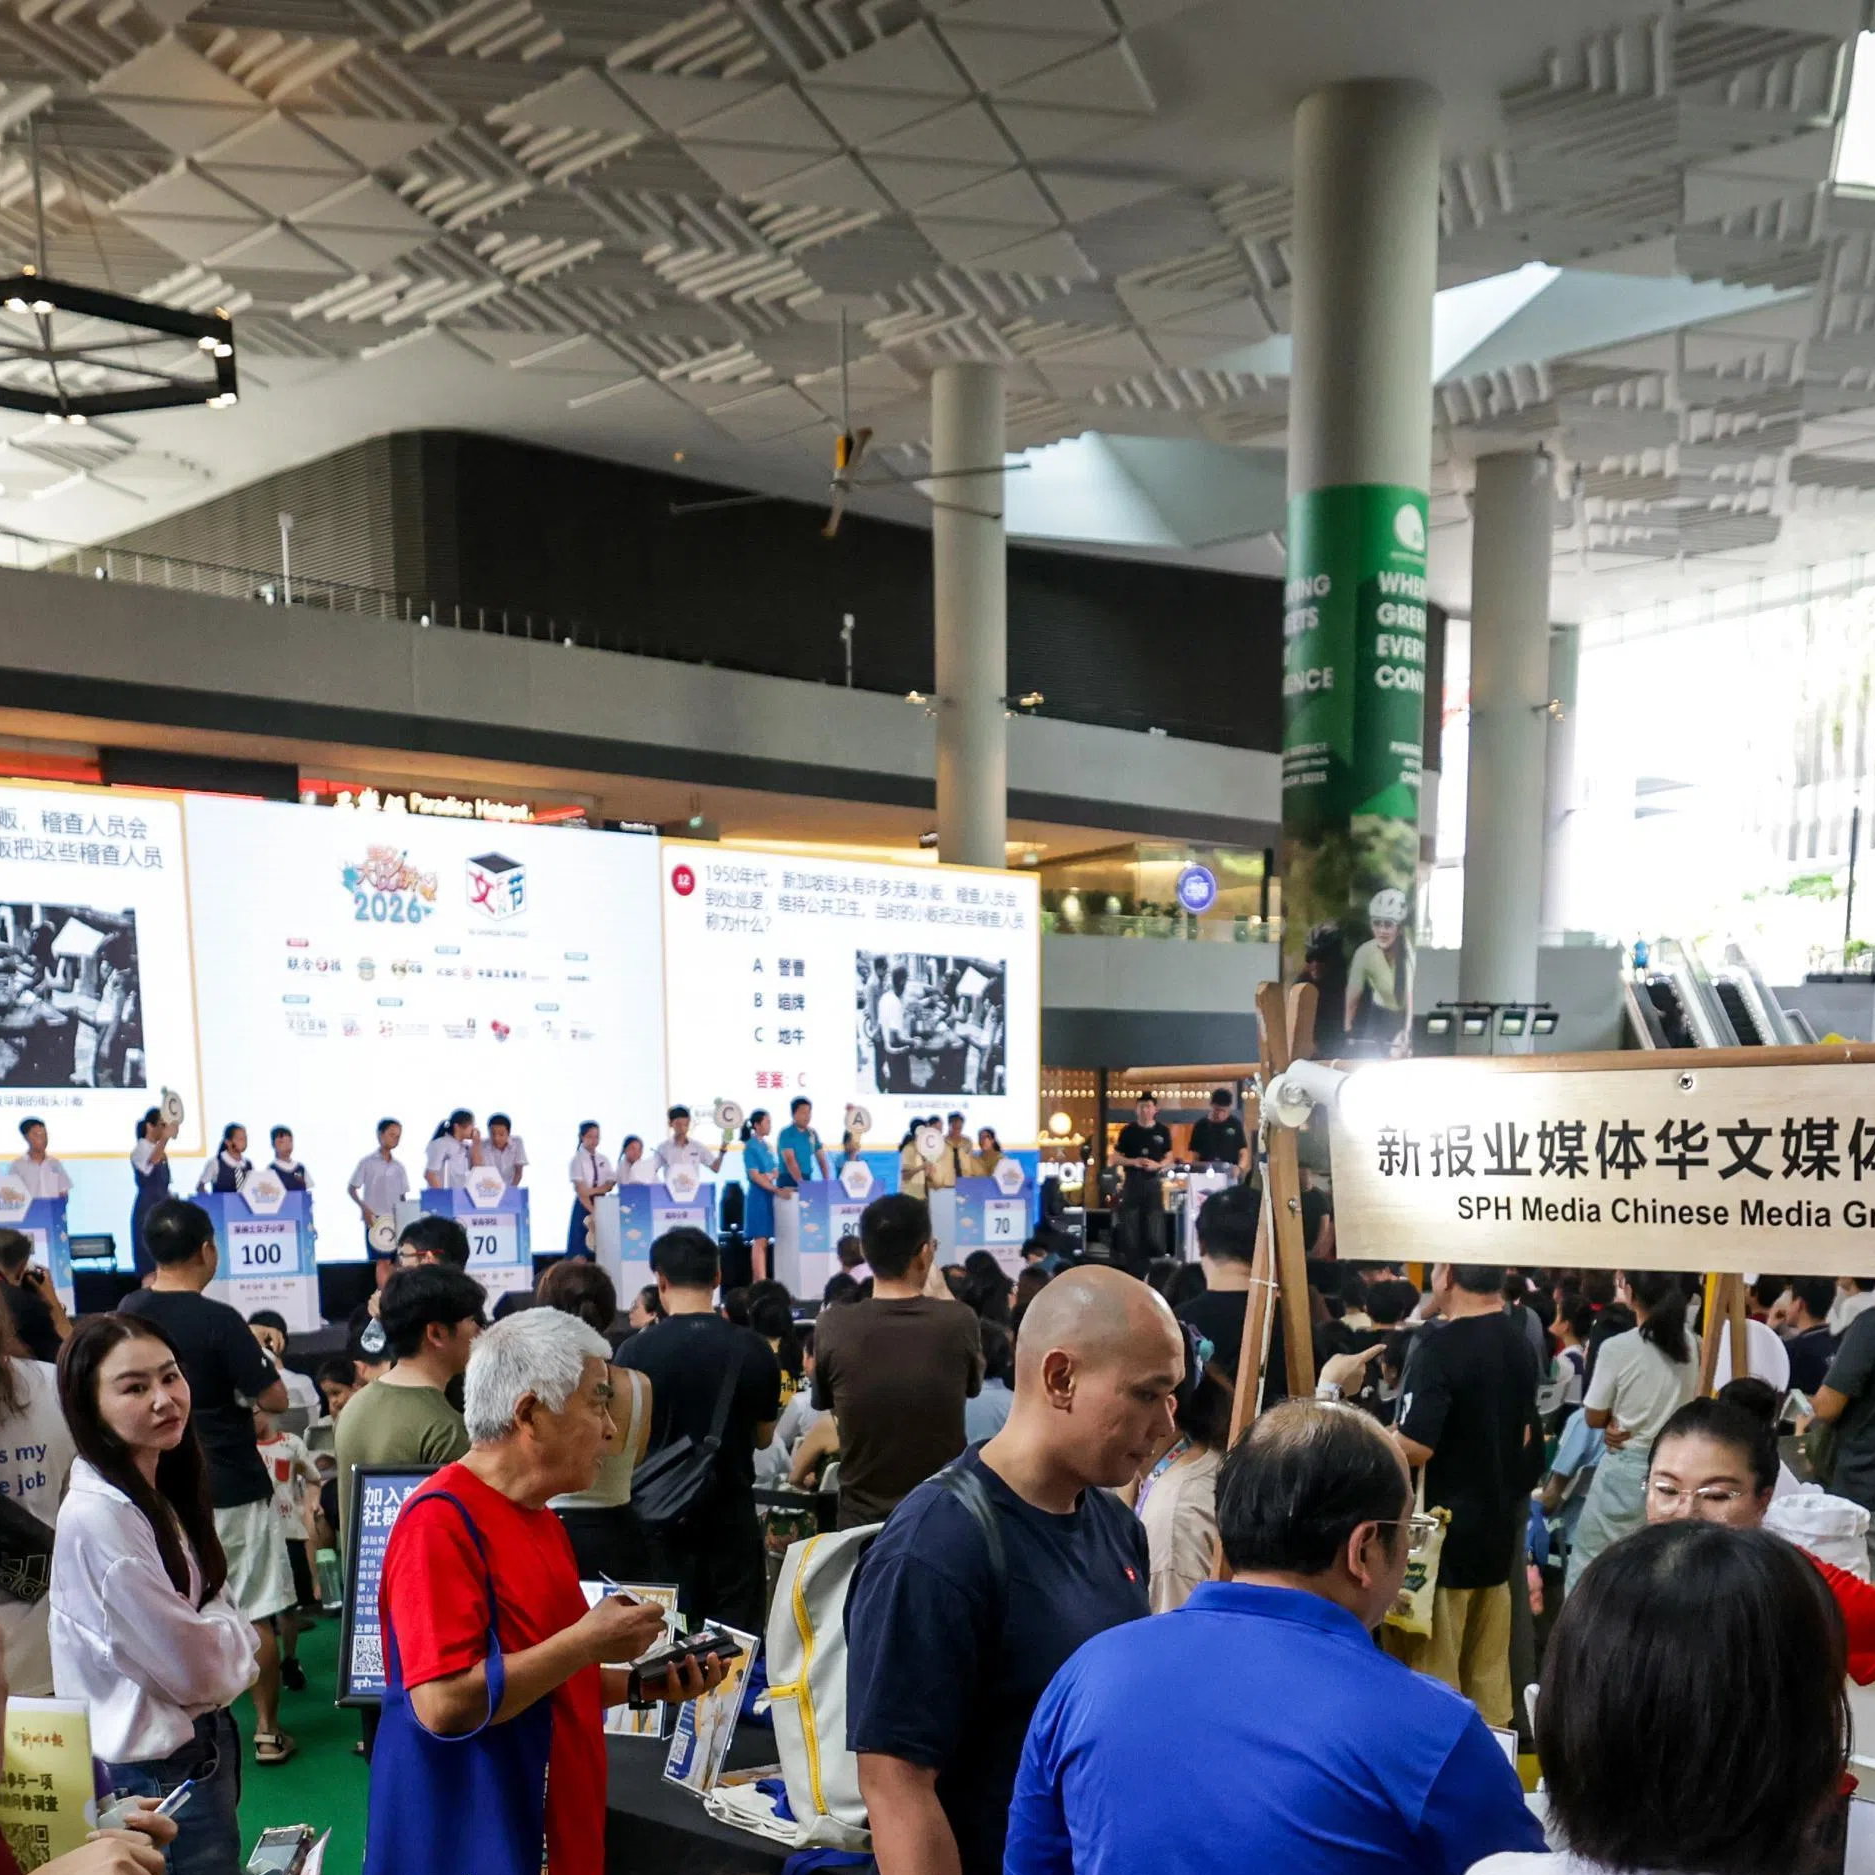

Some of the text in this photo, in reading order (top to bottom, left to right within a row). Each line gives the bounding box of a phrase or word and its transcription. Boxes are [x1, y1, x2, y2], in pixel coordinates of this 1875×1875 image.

[354, 893, 422, 924] 2026
[752, 958, 764, 973] A
[754, 993, 763, 1008] B
[754, 1027, 806, 1046] C 地牛
[169, 1097, 179, 1116] C
[723, 1107, 736, 1122] C
[852, 1111, 864, 1125] A
[925, 1134, 936, 1149] C
[1456, 1196, 1513, 1222] SPH
[1521, 1197, 1602, 1224] Media
[1611, 1198, 1730, 1227] Chinese
[1740, 1200, 1832, 1229] Media
[994, 1217, 1010, 1234] 70
[473, 1234, 497, 1255] 70
[242, 1243, 281, 1266] 100
[15, 1443, 47, 1463] my
[17, 1471, 46, 1496] job
[353, 1678, 372, 1691] sph
